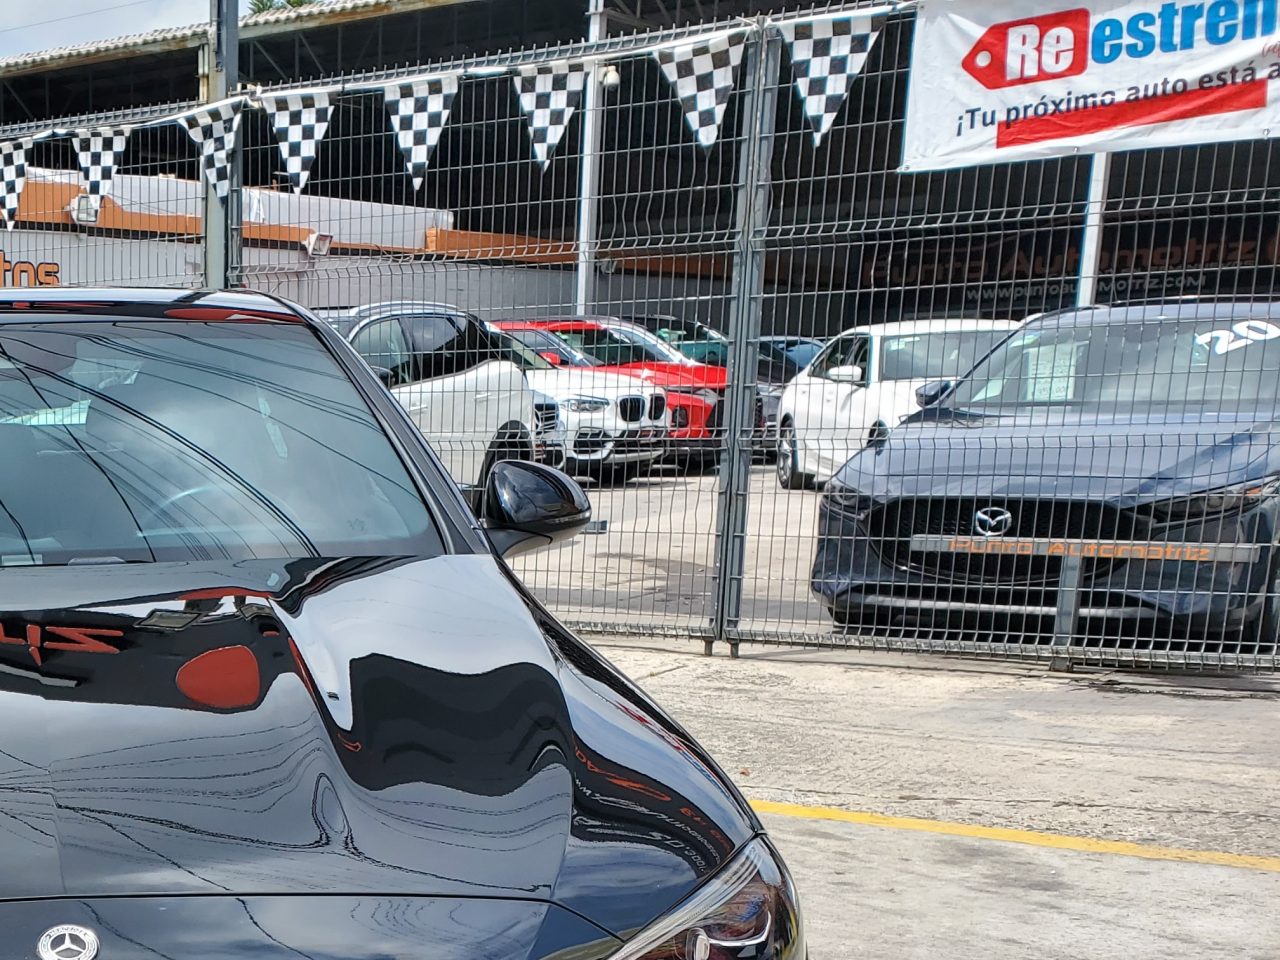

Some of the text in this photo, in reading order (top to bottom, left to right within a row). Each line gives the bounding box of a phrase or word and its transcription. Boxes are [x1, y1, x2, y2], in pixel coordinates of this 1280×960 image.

[956, 107, 997, 137] ¡Tu
[1006, 91, 1116, 128] próximo
[1125, 77, 1189, 104] auto
[1198, 60, 1257, 91] está
[949, 538, 1211, 561] Punto Automotriz
